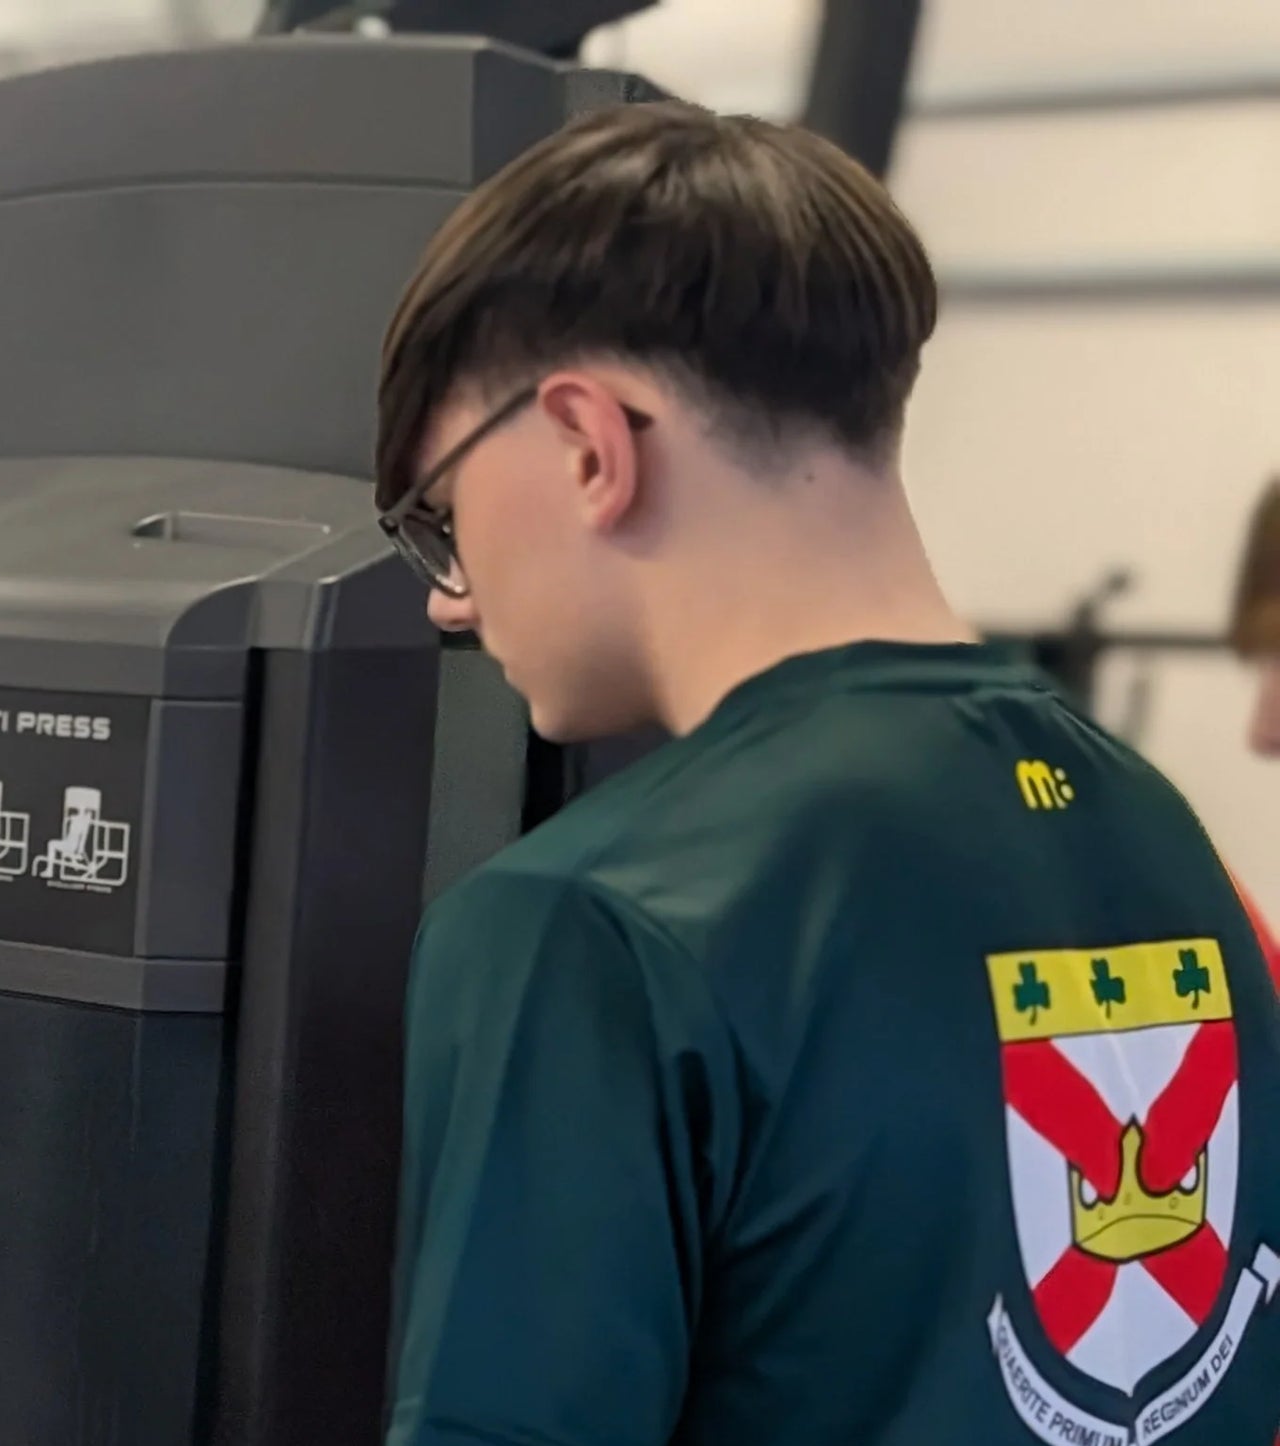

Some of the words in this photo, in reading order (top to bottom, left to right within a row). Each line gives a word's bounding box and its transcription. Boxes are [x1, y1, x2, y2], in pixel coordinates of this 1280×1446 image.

[16, 711, 111, 740] PRESS
[1141, 1372, 1212, 1438] REGNUM
[1210, 1334, 1233, 1374] DEI
